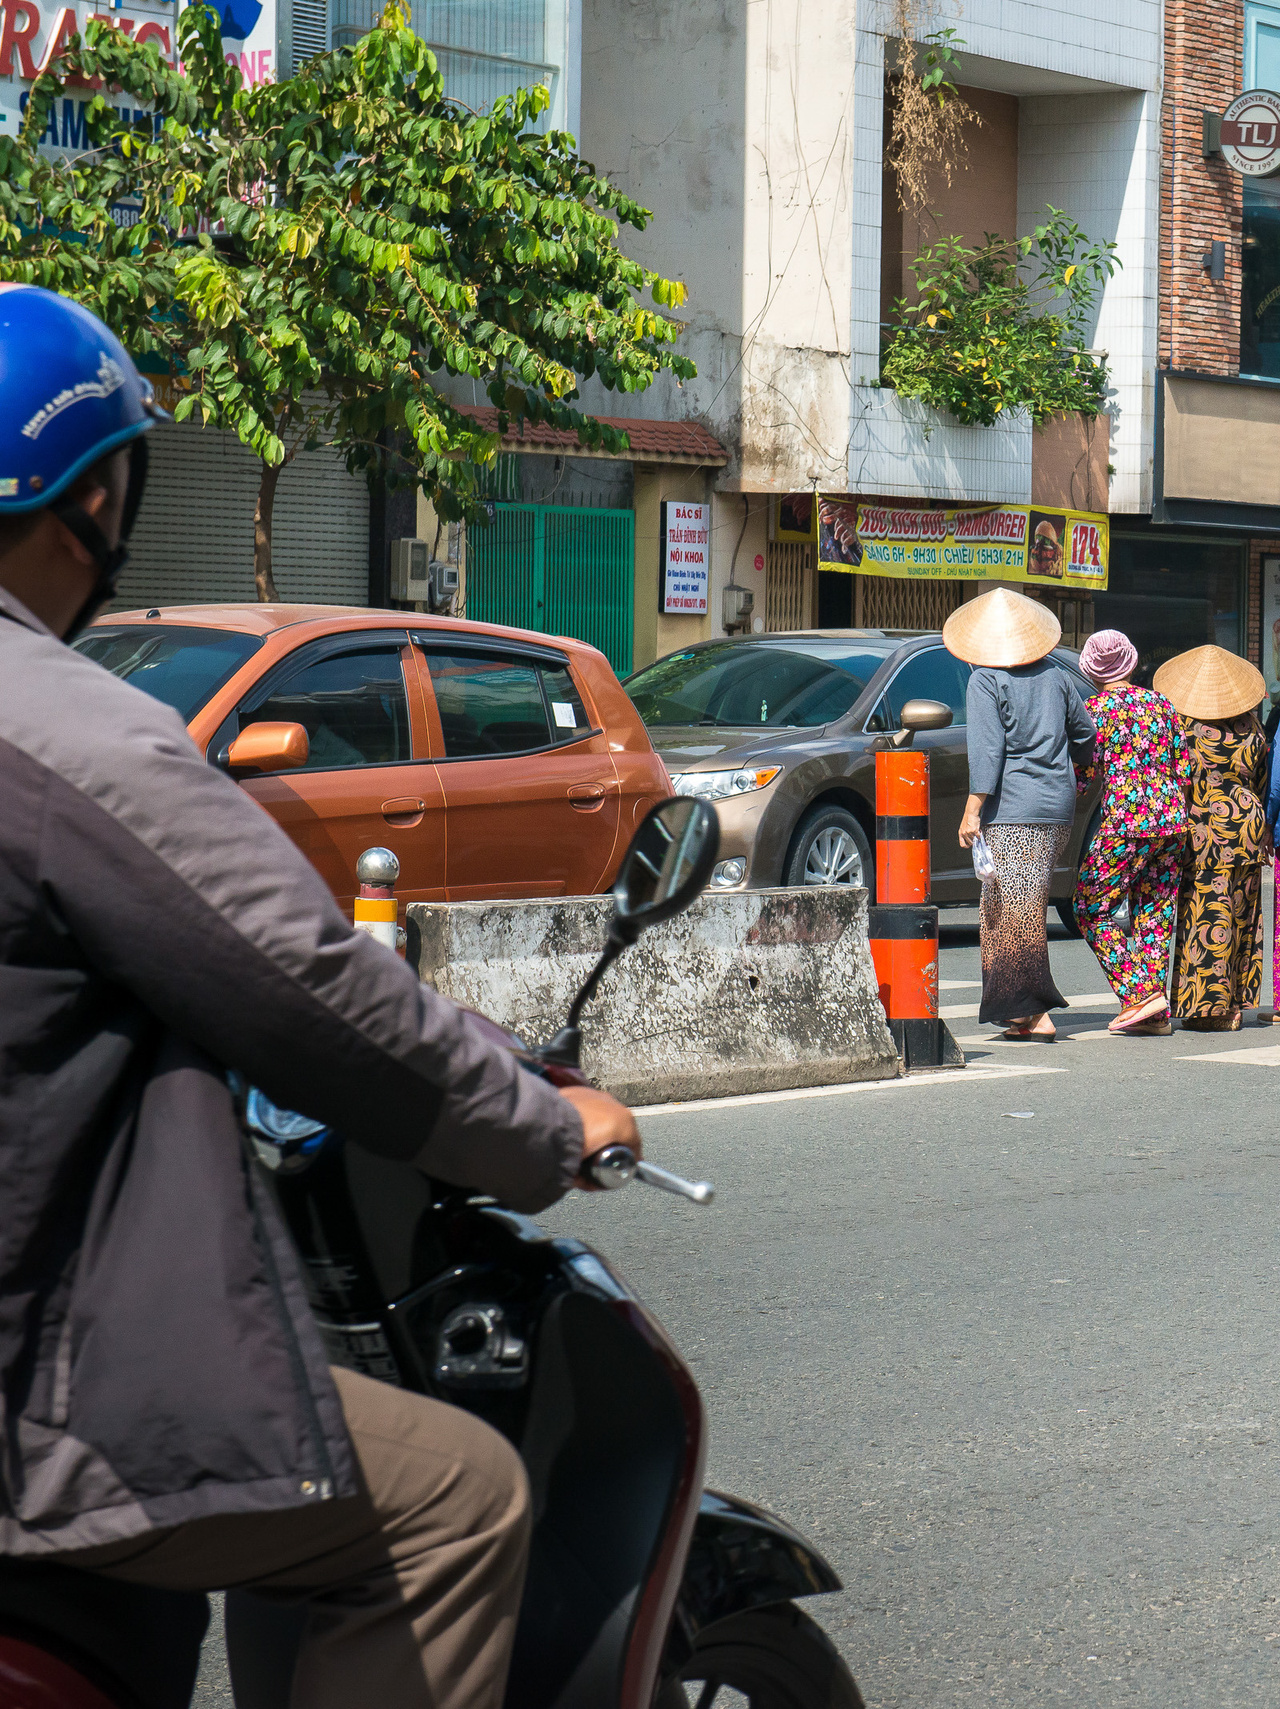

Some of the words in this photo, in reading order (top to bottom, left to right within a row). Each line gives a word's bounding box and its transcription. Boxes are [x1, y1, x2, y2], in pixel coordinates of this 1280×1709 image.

[1229, 95, 1267, 119] AUTHENTIC
[1237, 123, 1277, 146] TLJ
[1231, 154, 1255, 171] SINCE
[1257, 158, 1275, 170] 1997
[675, 506, 693, 519] BÁC
[859, 507, 888, 533] XÚC
[889, 509, 920, 535] XÍCH
[955, 511, 1027, 539] HAMBURGER
[670, 548, 683, 564] NỘI
[684, 550, 704, 563] KHOA
[864, 541, 891, 562] SÁNG
[892, 546, 905, 563] 6H
[913, 547, 936, 564] 9H30
[1072, 523, 1100, 566] 174
[907, 567, 930, 576] SUNDAY
[931, 567, 942, 576] OFF
